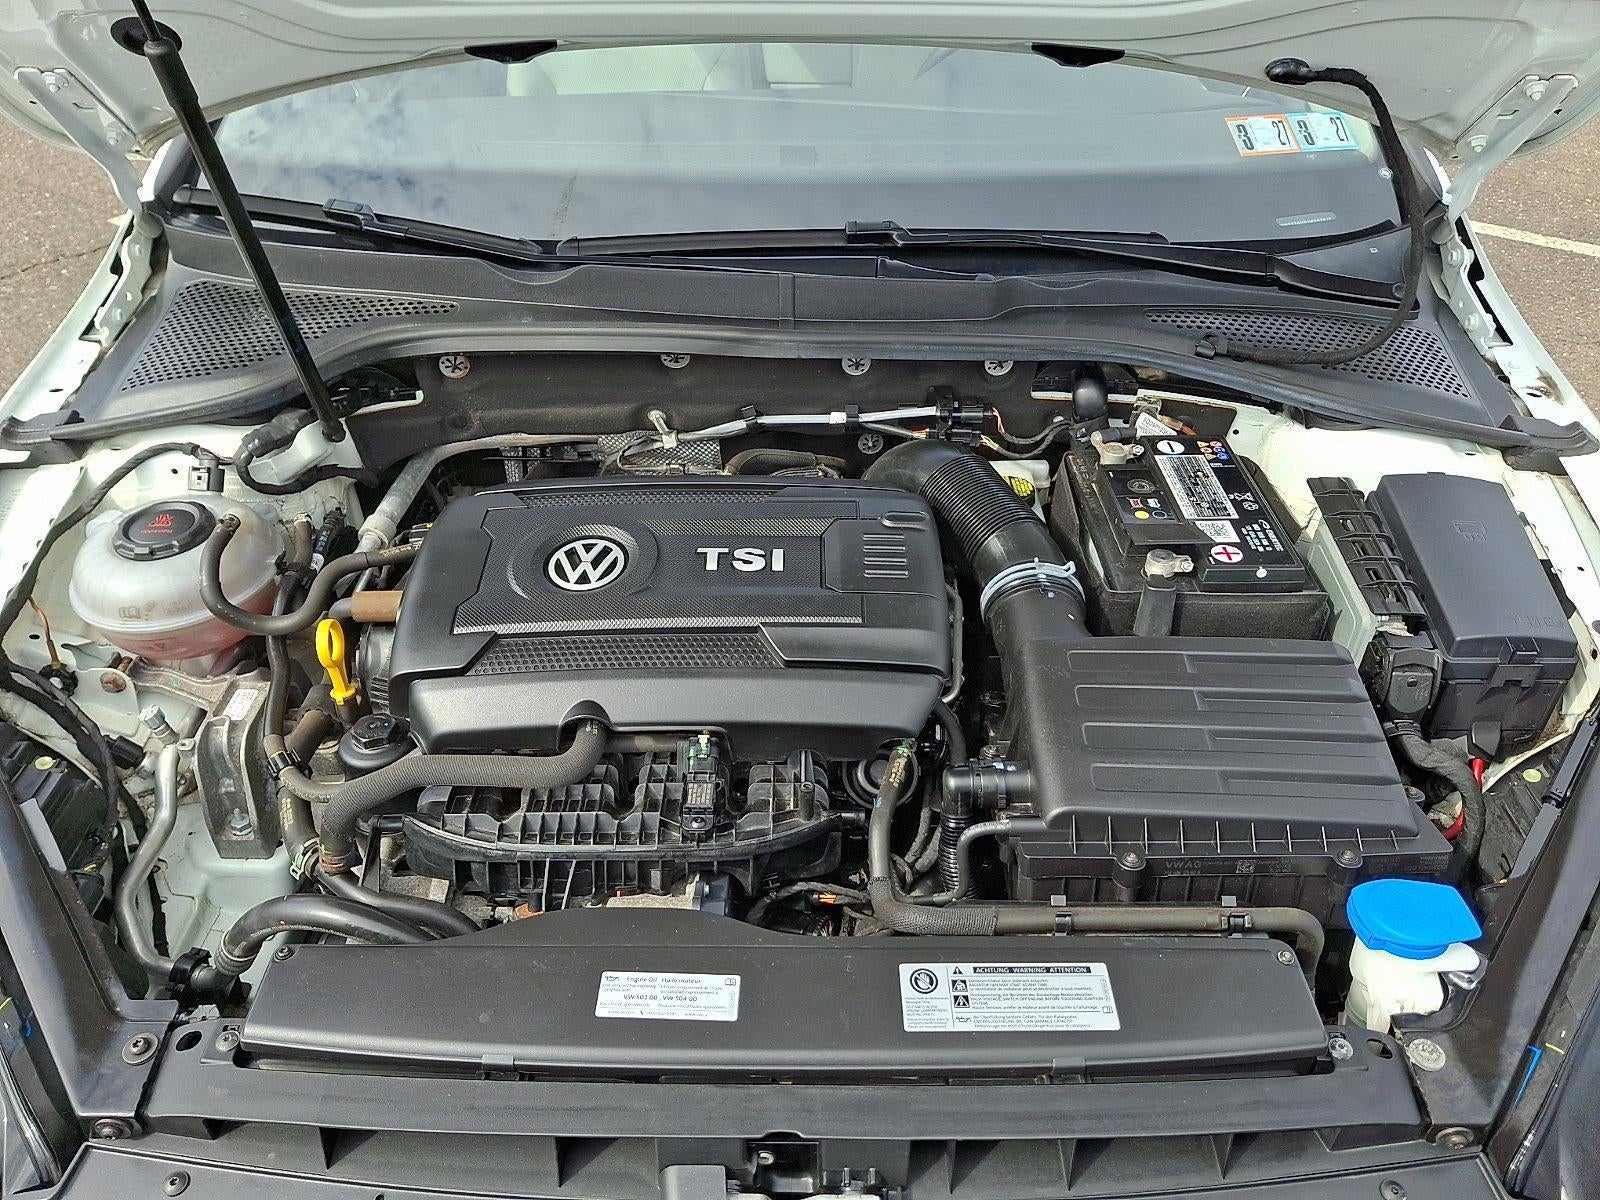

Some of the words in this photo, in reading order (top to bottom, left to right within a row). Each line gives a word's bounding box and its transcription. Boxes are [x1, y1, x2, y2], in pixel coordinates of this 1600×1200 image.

[1236, 123, 1254, 150] 3
[1271, 120, 1291, 146] 27
[1296, 119, 1315, 146] 3
[1329, 116, 1349, 142] 27
[696, 546, 785, 573] TSI
[626, 976, 647, 984] Engine
[975, 966, 1009, 974] ACHTUNG
[1012, 966, 1046, 974] WARNING
[1049, 966, 1087, 974] ATTENTION
